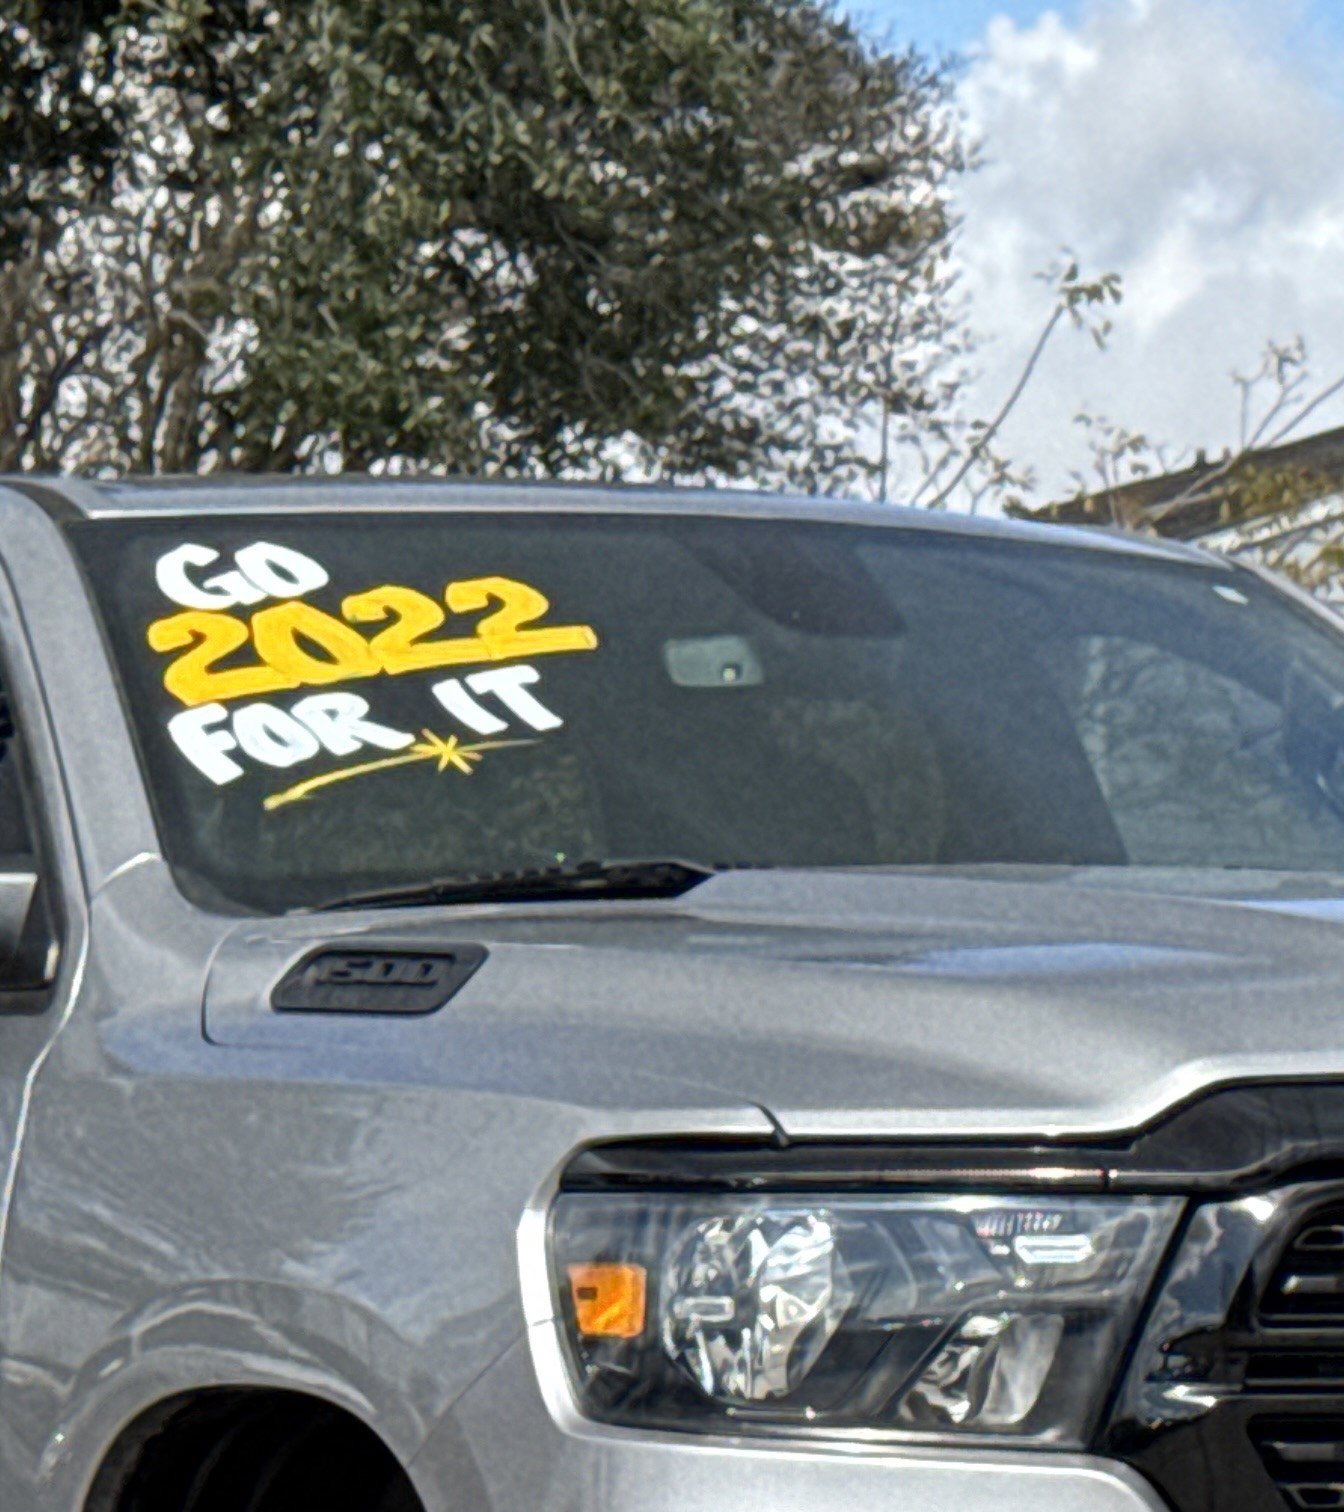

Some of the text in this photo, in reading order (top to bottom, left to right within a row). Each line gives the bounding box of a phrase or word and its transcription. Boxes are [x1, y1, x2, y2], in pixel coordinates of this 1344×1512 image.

[155, 540, 330, 610] GO
[146, 576, 599, 707] 2022
[166, 663, 564, 786] FOR IT
